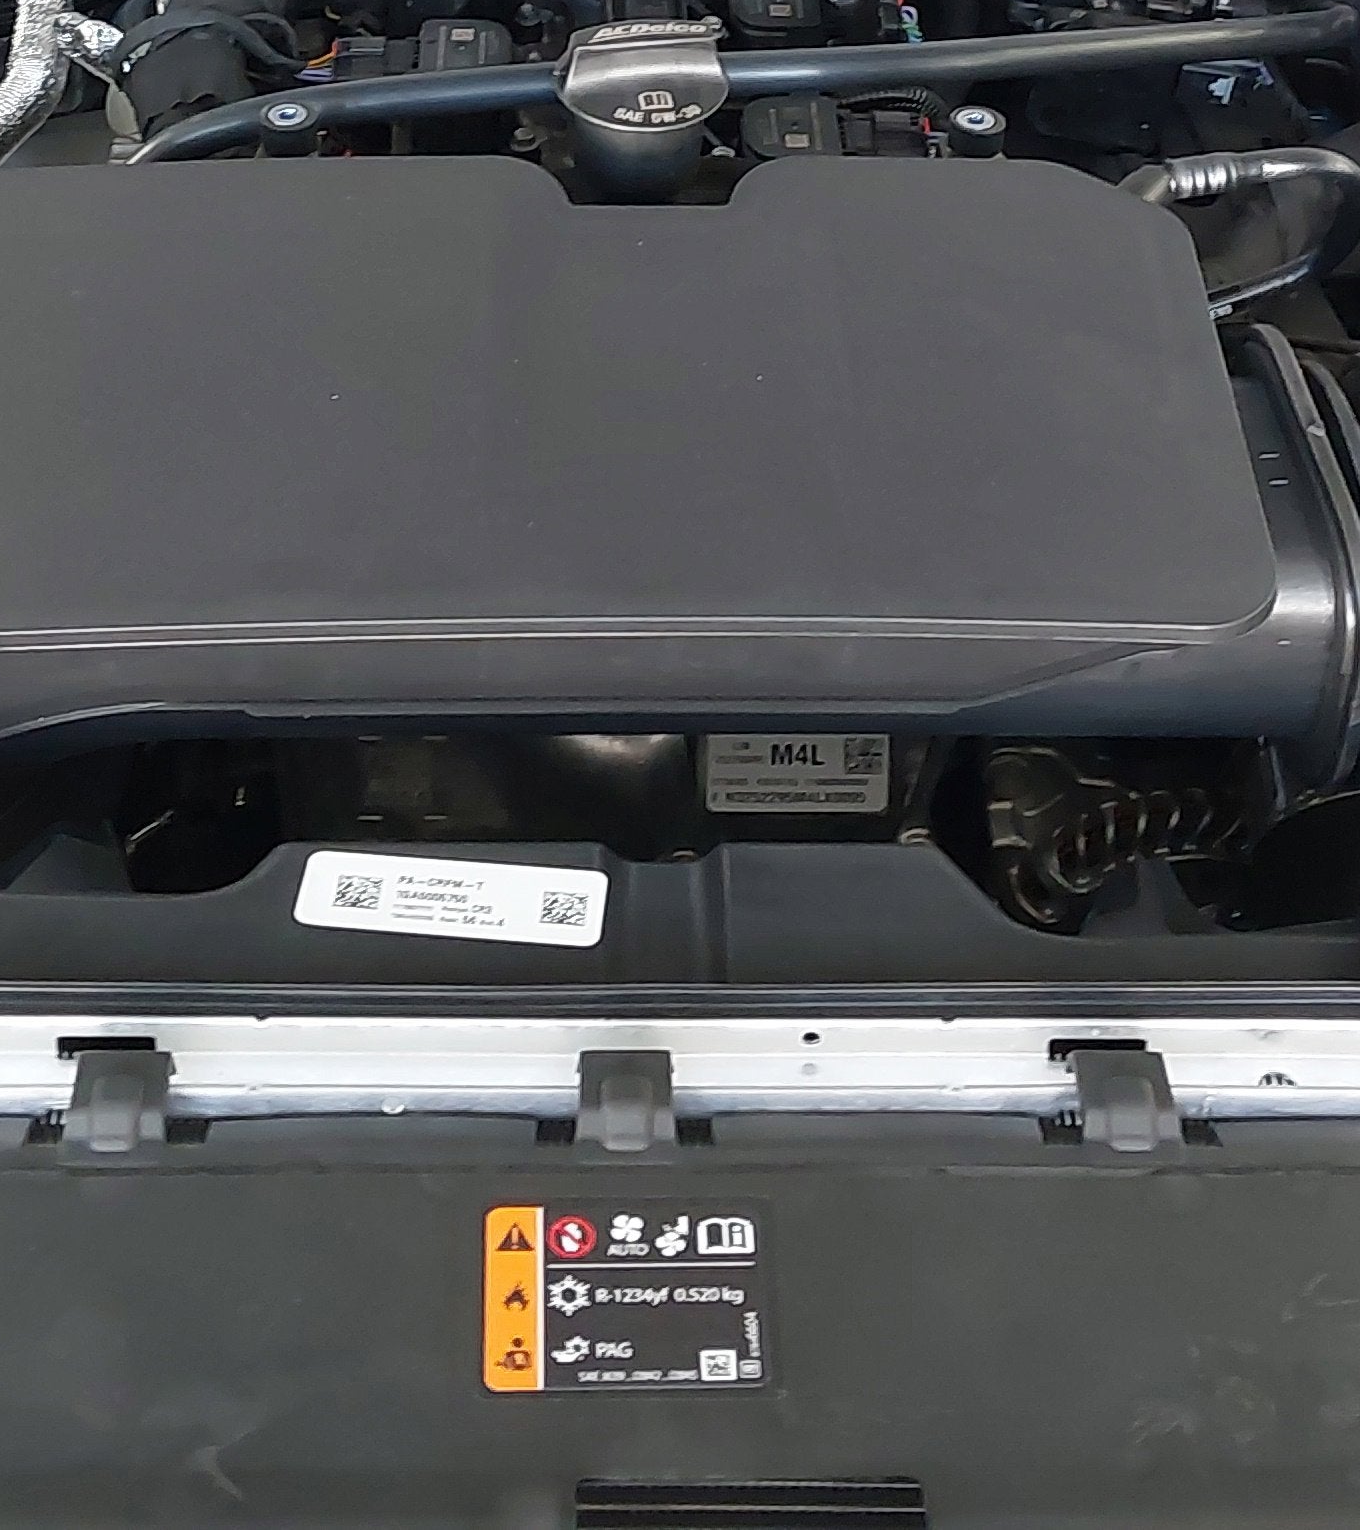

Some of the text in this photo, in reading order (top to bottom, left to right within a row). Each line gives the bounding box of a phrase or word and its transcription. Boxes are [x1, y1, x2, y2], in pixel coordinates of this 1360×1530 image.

[593, 22, 708, 39] ACDelco
[770, 743, 826, 766] M4L
[607, 1243, 650, 1257] AUTO
[594, 1286, 670, 1306] R-1234yf
[721, 1286, 745, 1306] kg
[595, 1340, 635, 1359] PAG
